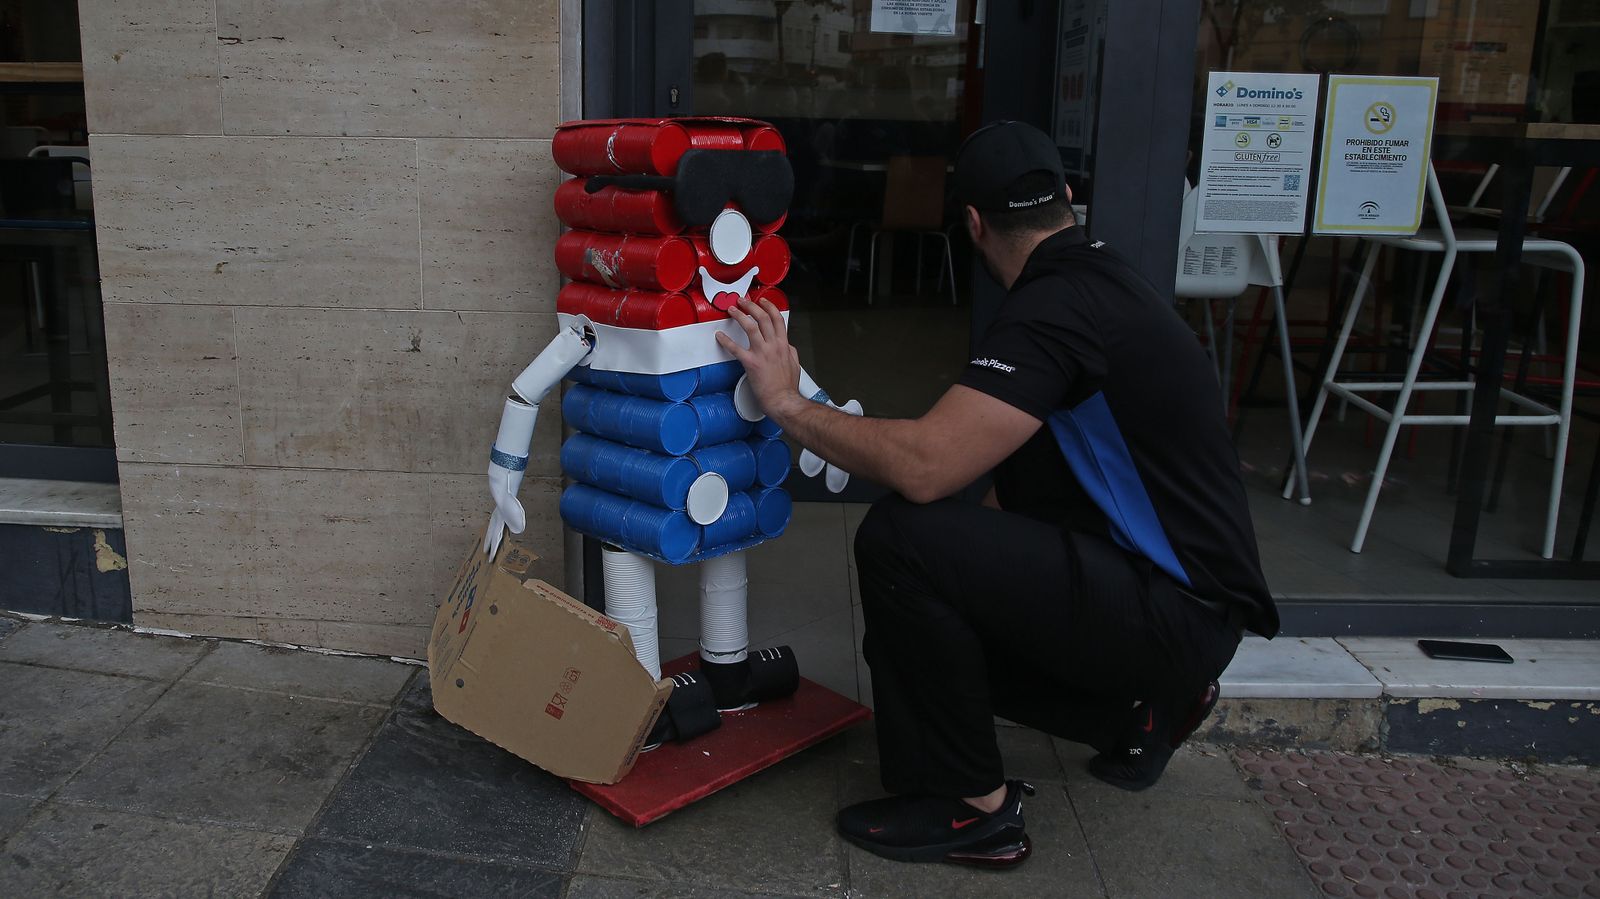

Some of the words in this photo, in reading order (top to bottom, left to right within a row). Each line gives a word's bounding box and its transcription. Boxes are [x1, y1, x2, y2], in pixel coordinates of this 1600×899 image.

[1236, 86, 1303, 100] Domino's
[1346, 138, 1383, 146] PROHIBIDO
[1384, 139, 1409, 147] FUMAR
[1344, 153, 1407, 161] ESTABLECIMIENTO
[1008, 198, 1037, 208] Domino's
